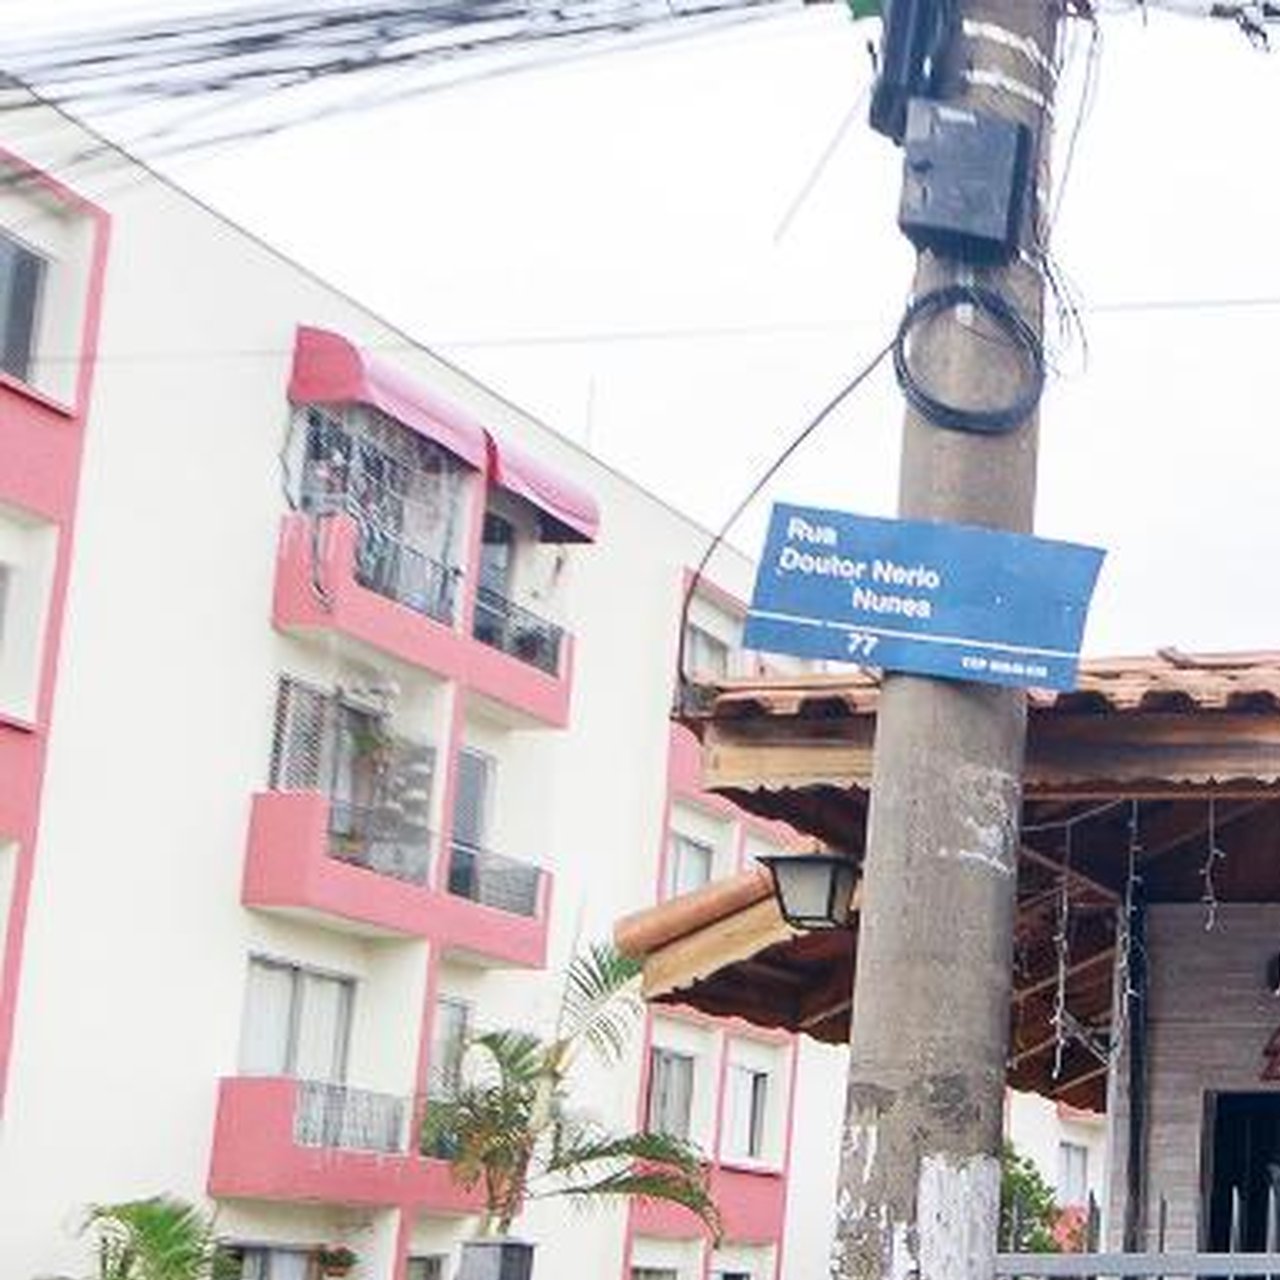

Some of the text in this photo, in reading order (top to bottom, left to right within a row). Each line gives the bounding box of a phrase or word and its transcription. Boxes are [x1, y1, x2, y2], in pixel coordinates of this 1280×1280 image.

[788, 517, 837, 545] Rua
[779, 547, 867, 579] Doutor
[852, 587, 931, 618] Nunes
[847, 632, 879, 656] 77
